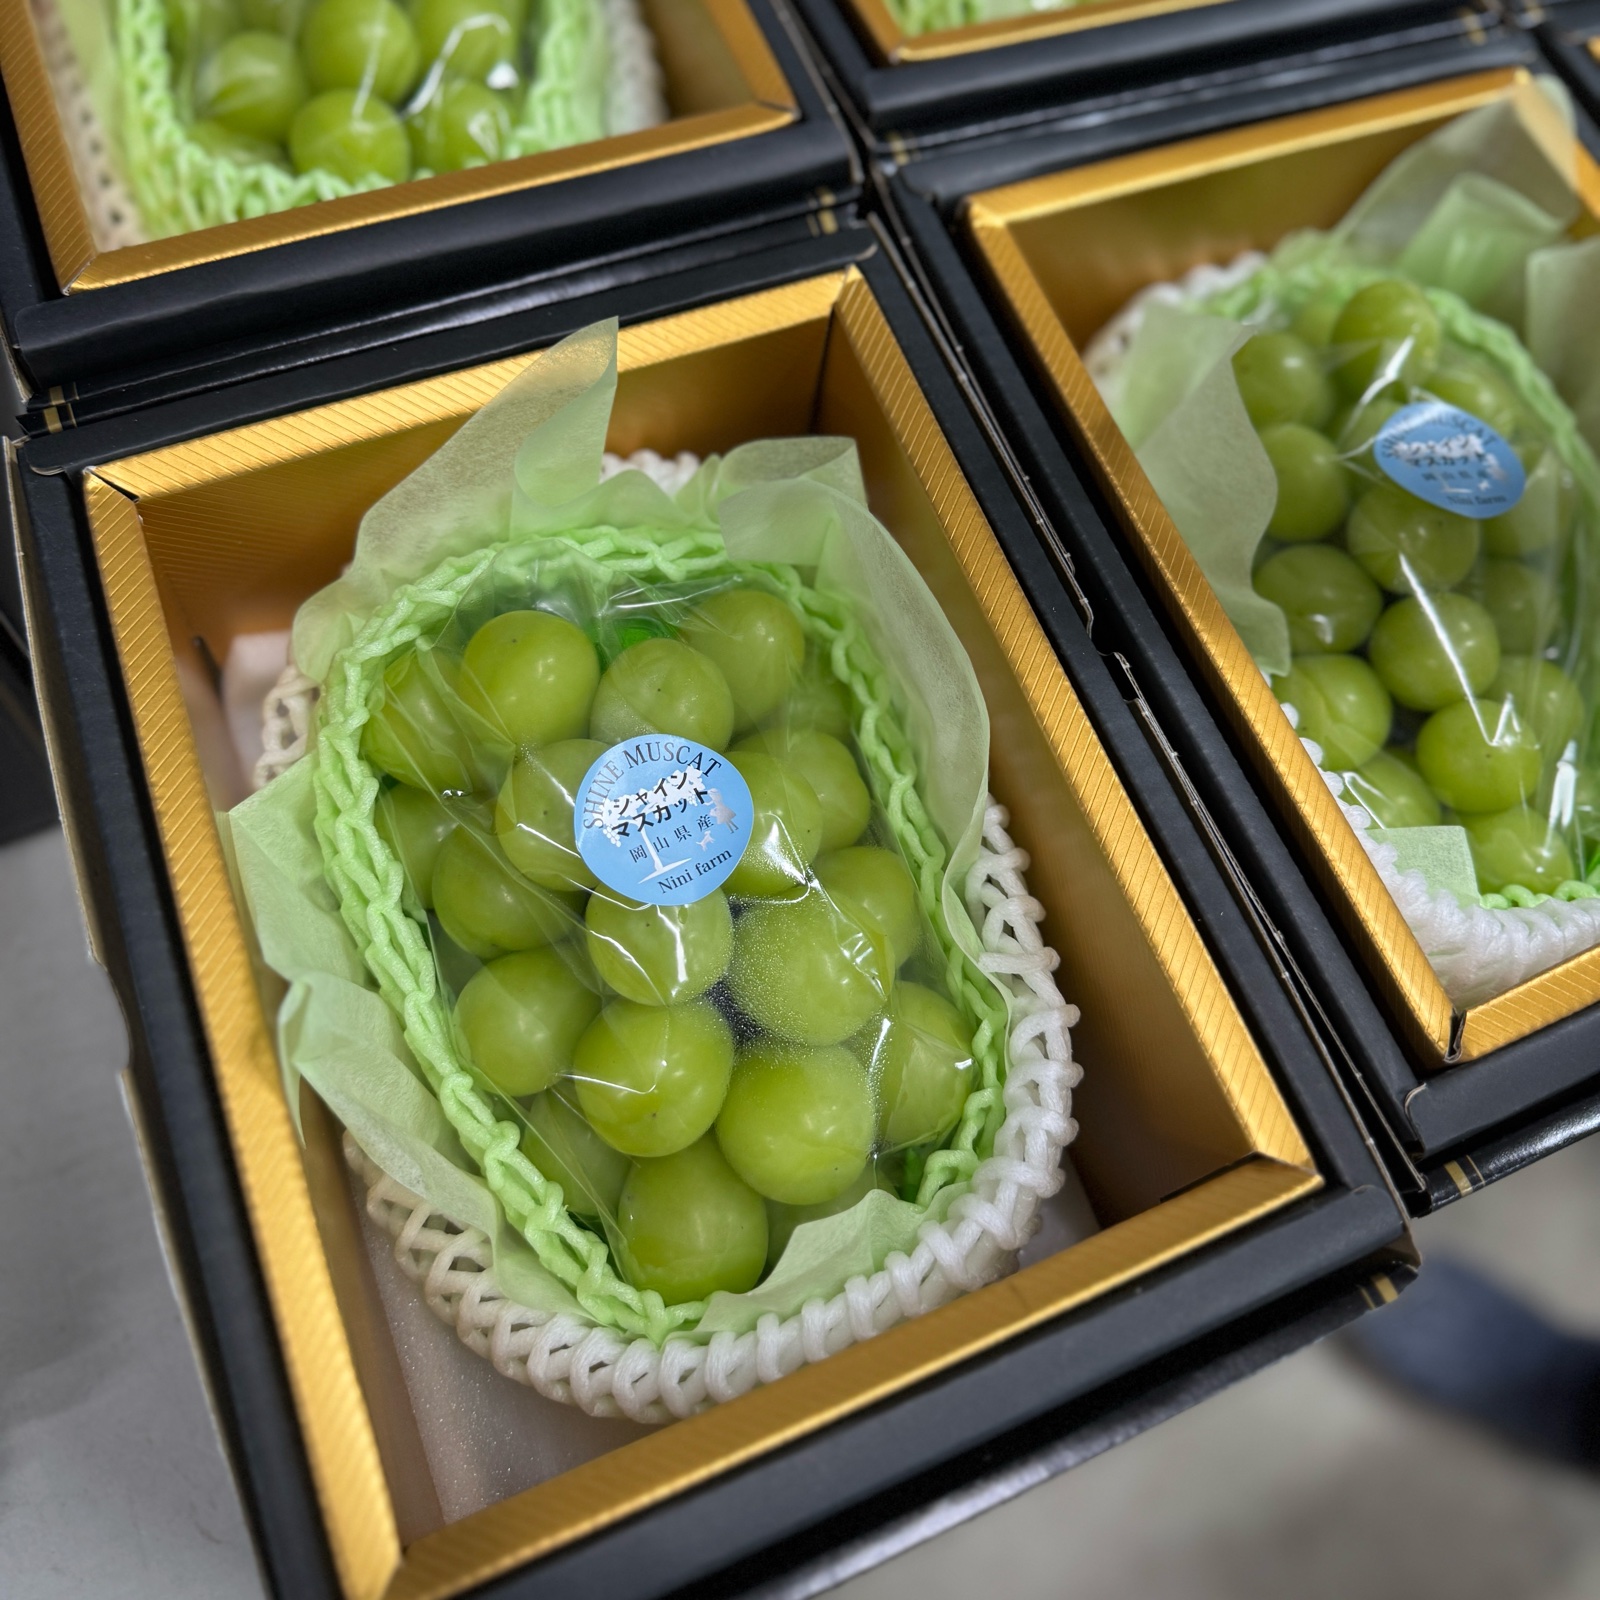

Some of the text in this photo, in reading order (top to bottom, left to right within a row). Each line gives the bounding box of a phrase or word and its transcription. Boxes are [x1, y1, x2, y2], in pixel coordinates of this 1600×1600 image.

[583, 742, 722, 829] SHINE MUSCAT
[613, 772, 688, 815] シャイン
[611, 787, 709, 838] マスカット
[629, 814, 714, 863] 岡山県産
[657, 848, 732, 894] Nini farm
